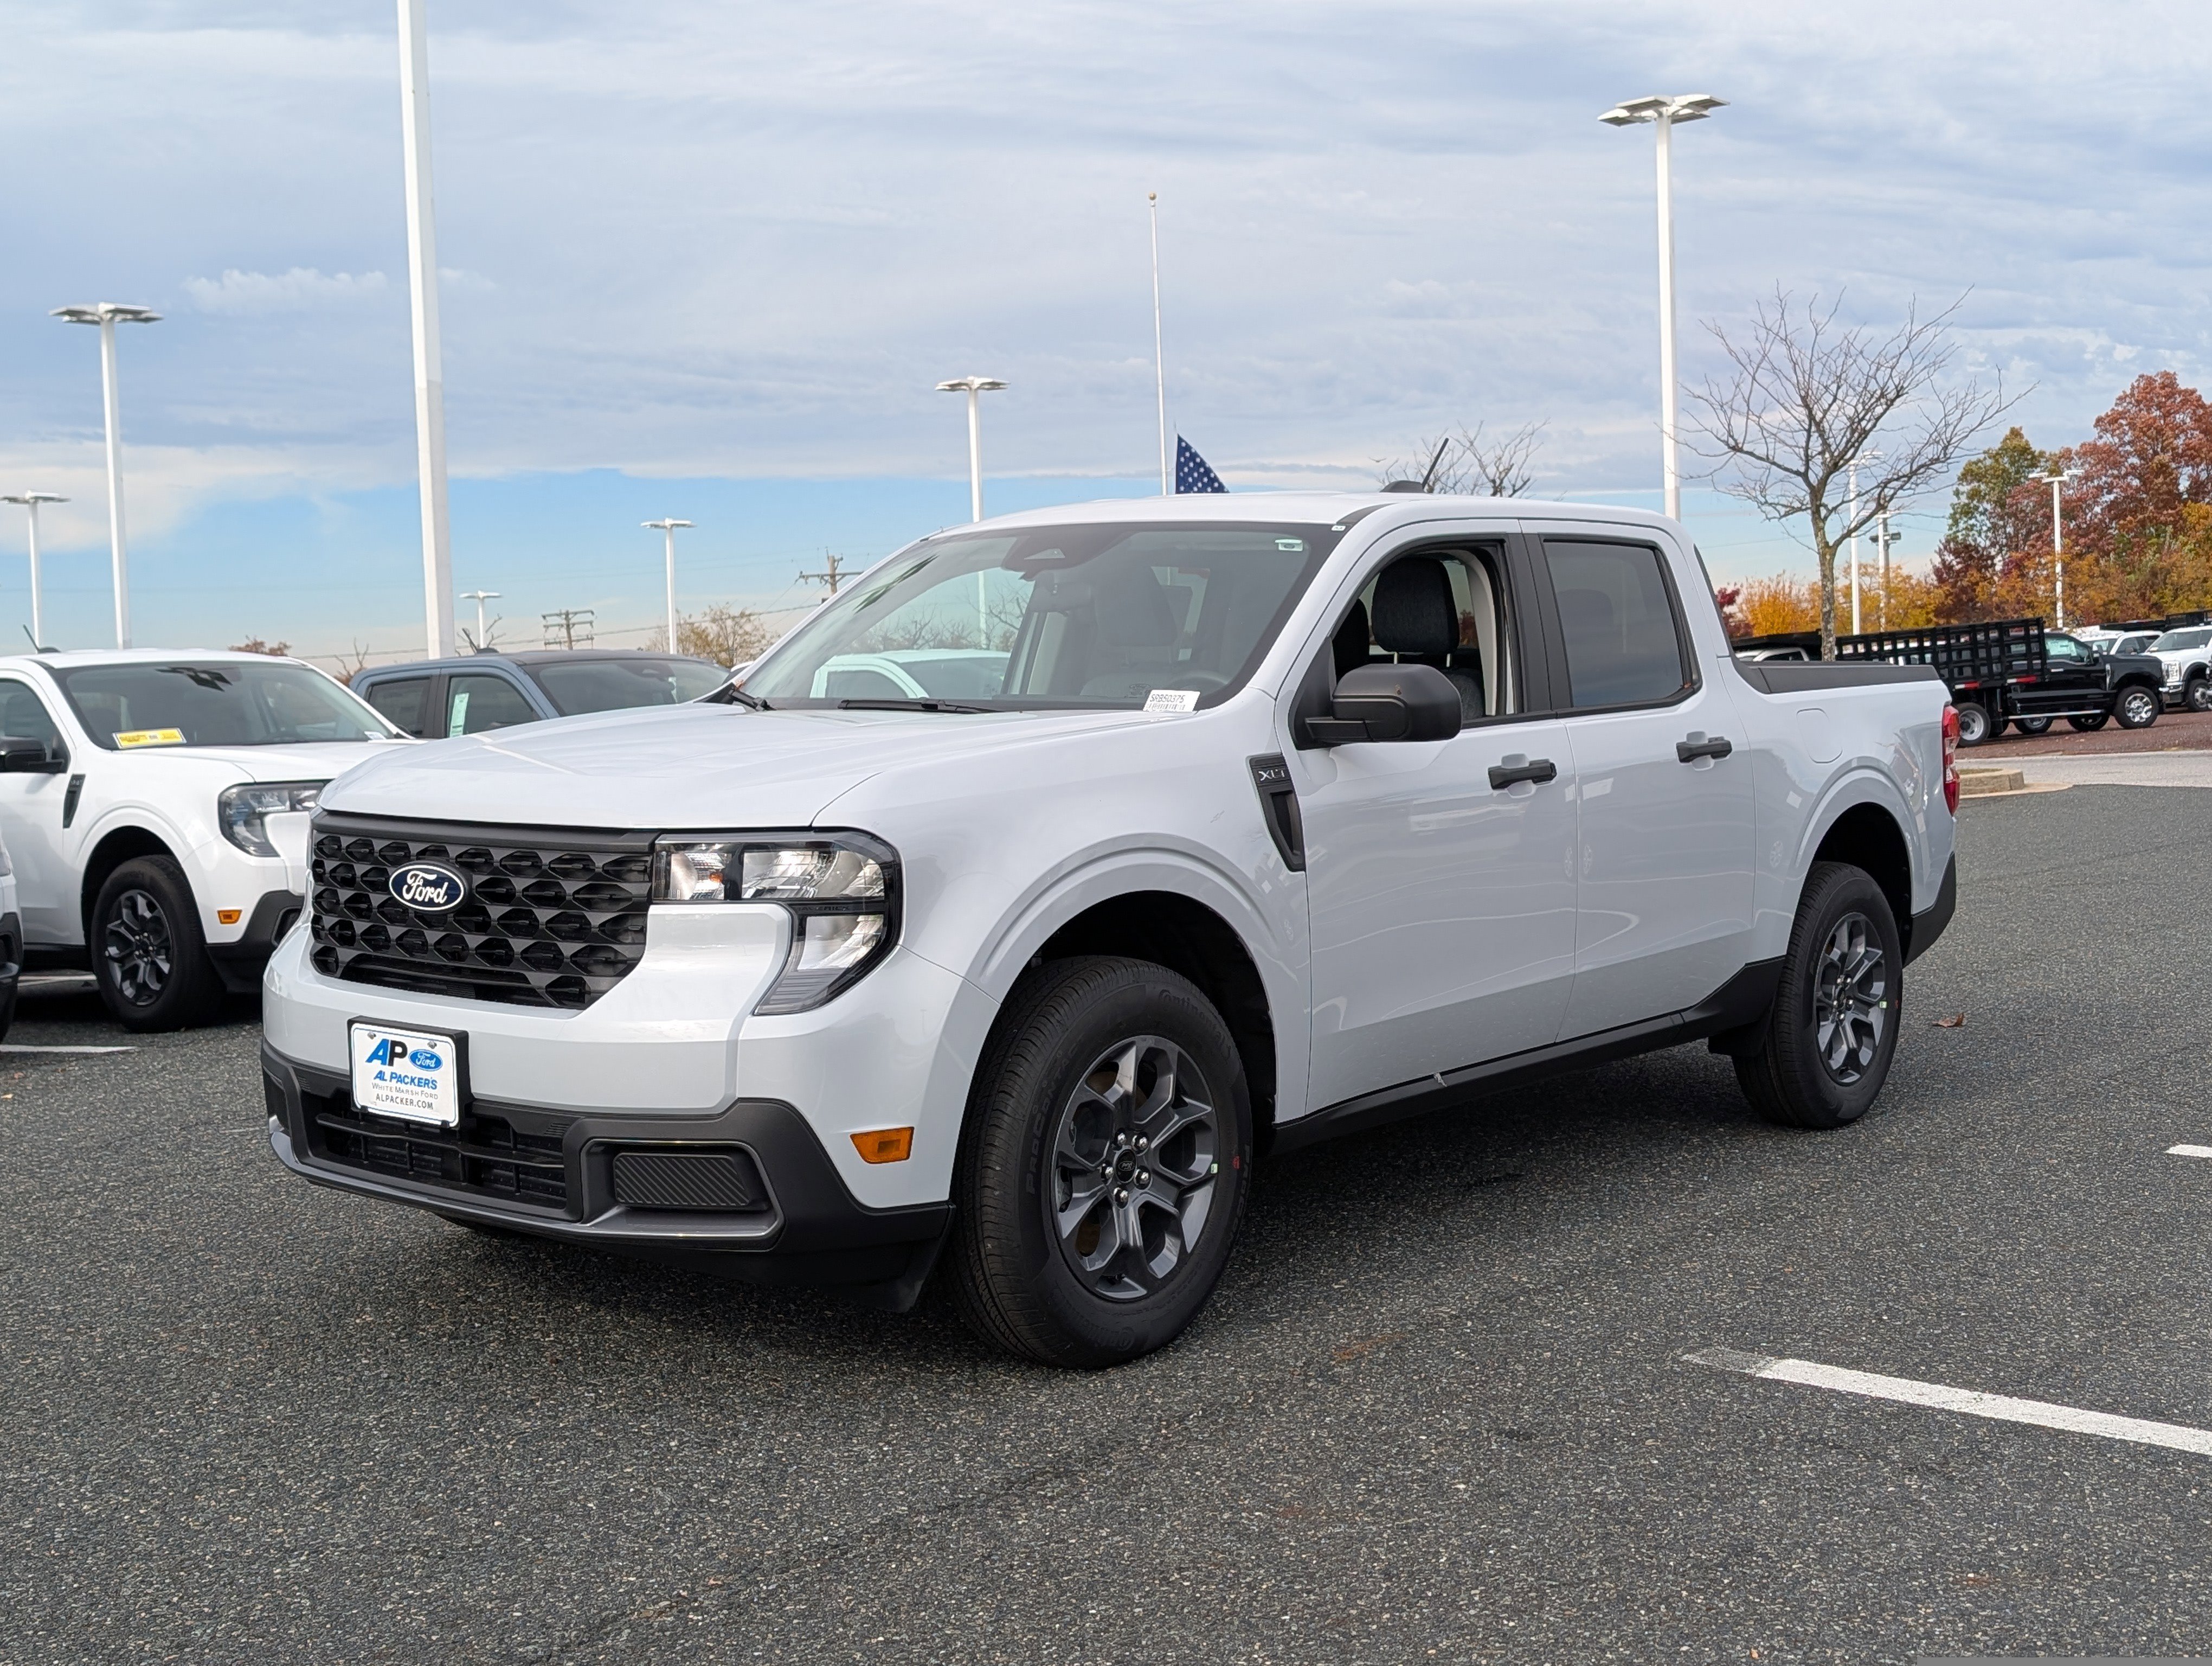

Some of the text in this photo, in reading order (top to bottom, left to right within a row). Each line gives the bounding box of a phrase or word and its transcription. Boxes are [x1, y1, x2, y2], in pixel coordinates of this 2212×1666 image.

[402, 870, 449, 904] Ford
[365, 1039, 408, 1067] AP
[415, 1052, 436, 1068] Ford
[374, 1070, 387, 1081] AL
[372, 1082, 438, 1100] WHITE MARSH FORD
[375, 1093, 434, 1110] ALPACKER.COM
